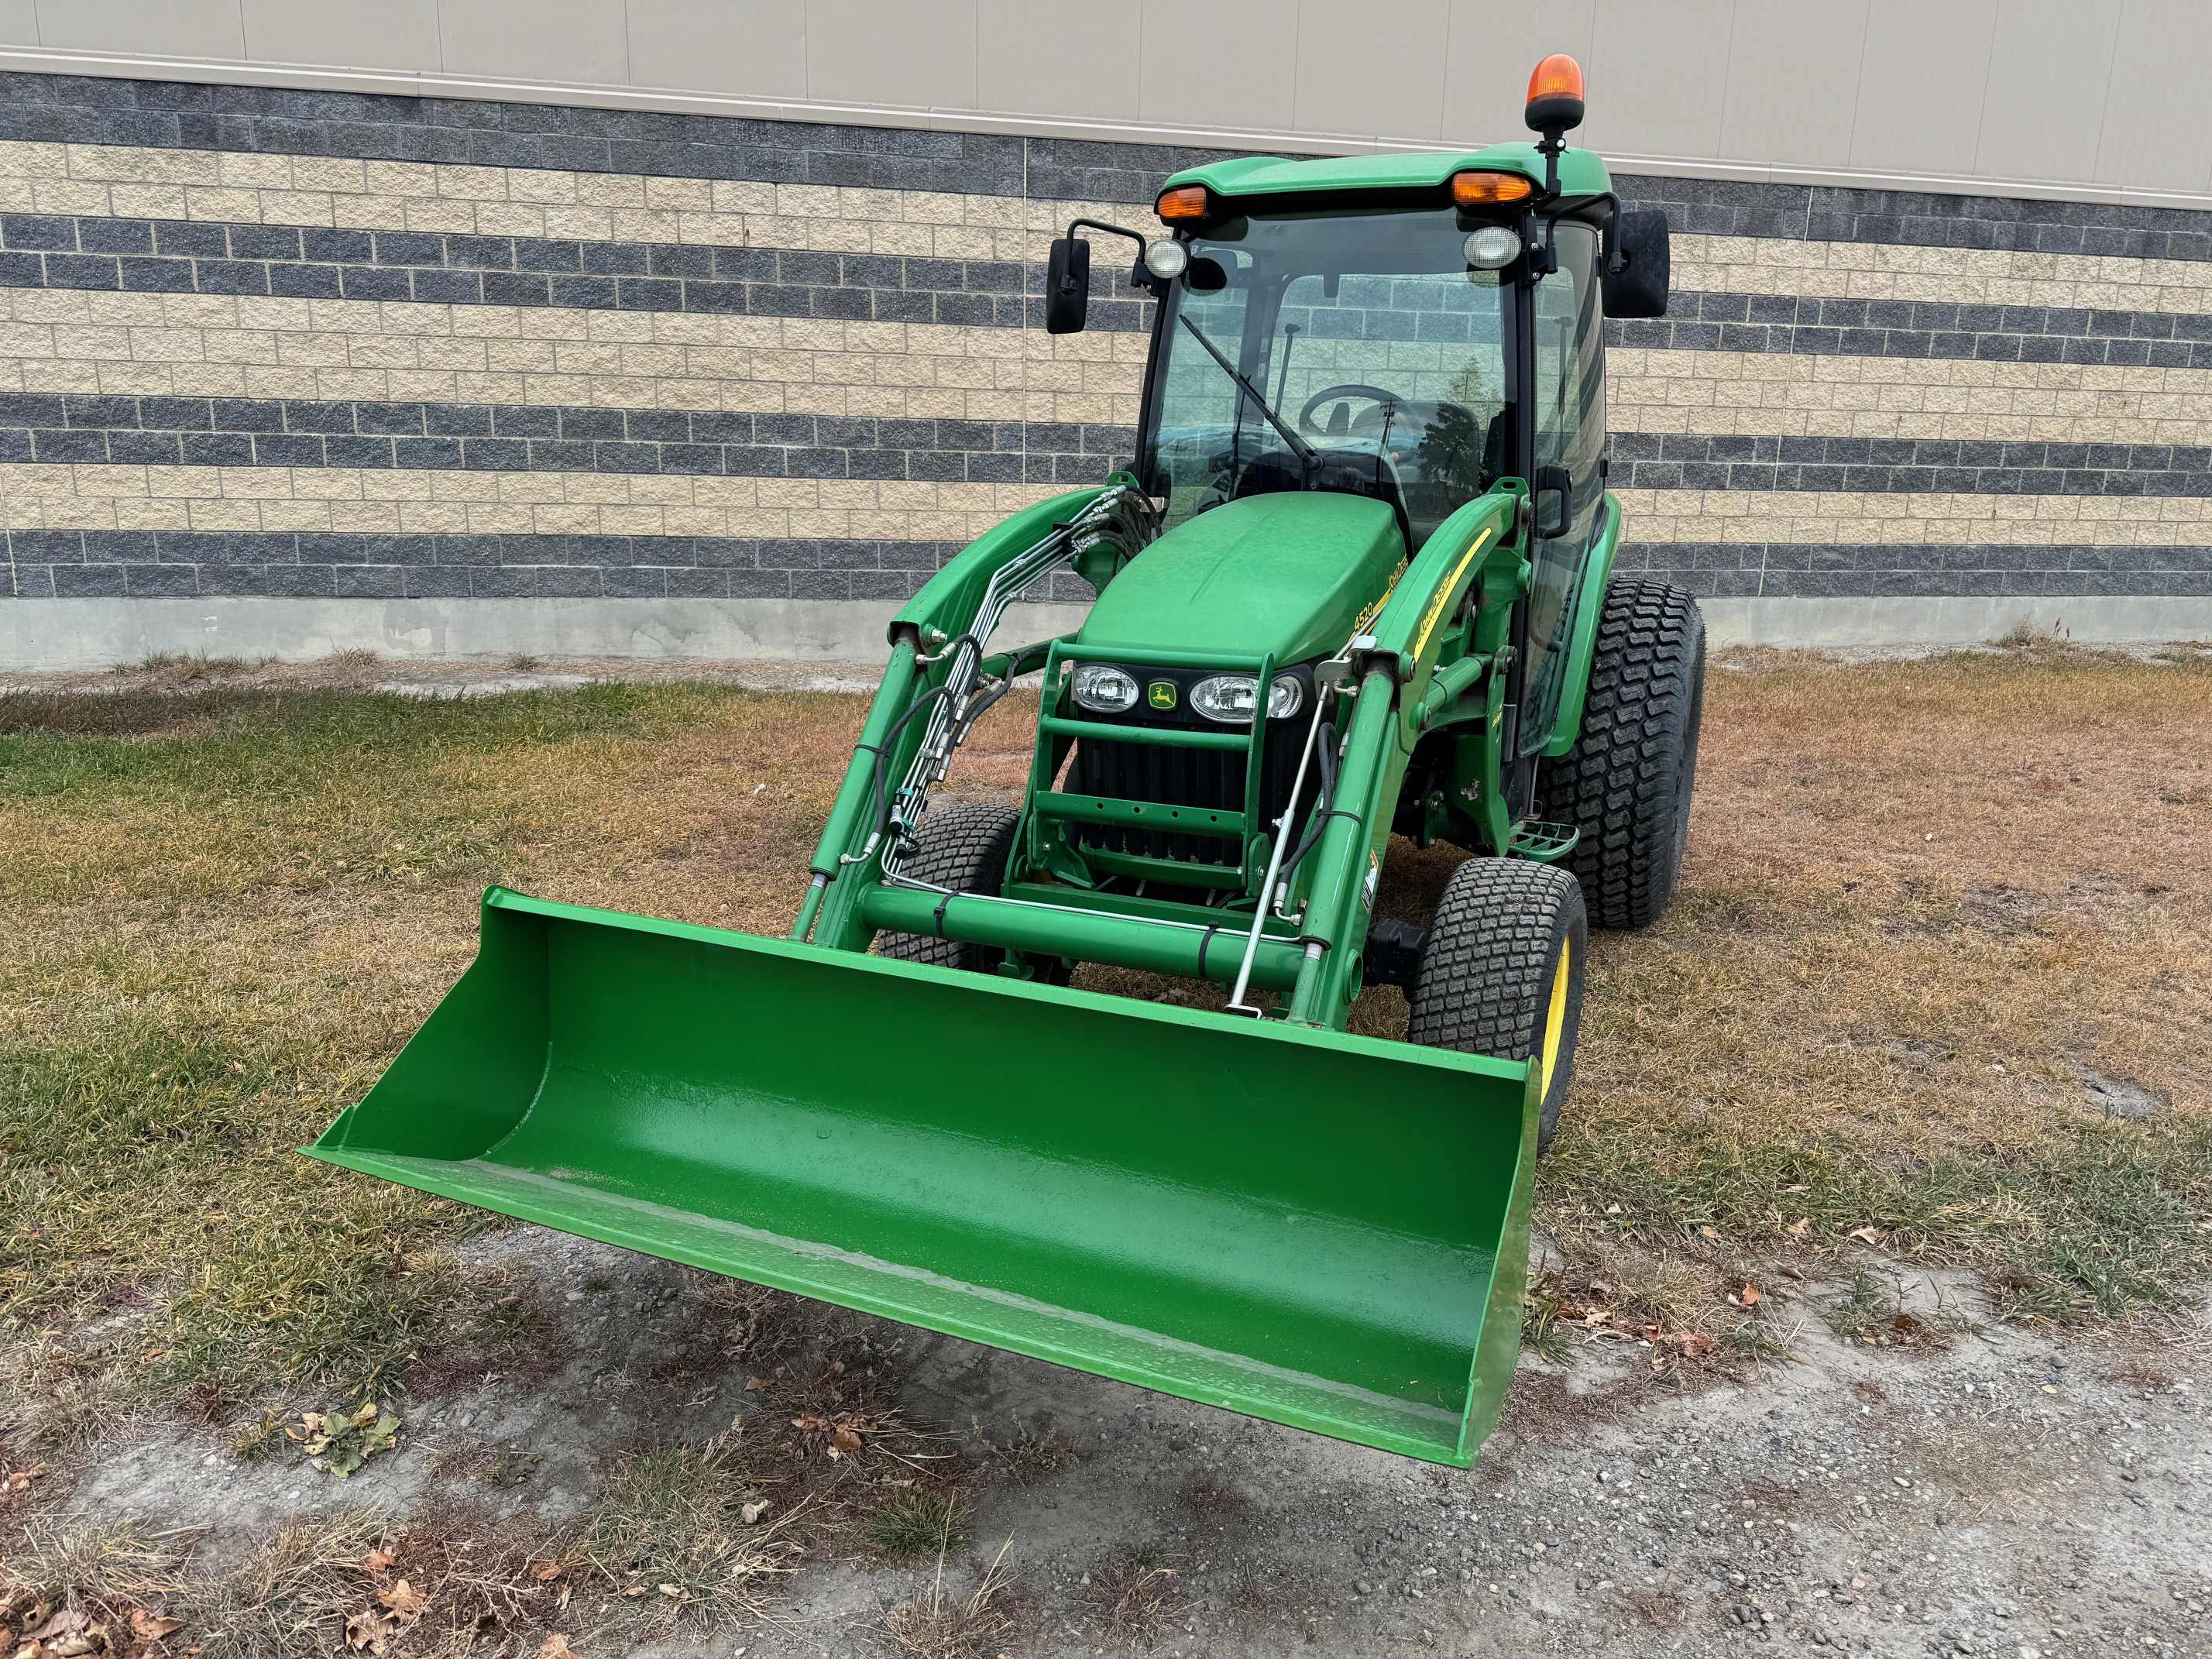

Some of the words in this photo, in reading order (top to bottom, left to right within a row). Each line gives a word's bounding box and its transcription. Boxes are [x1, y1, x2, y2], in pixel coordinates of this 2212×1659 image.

[1354, 601, 1373, 630] 4520
[1418, 603, 1434, 642] JOHN
[1433, 570, 1451, 608] DEERE
